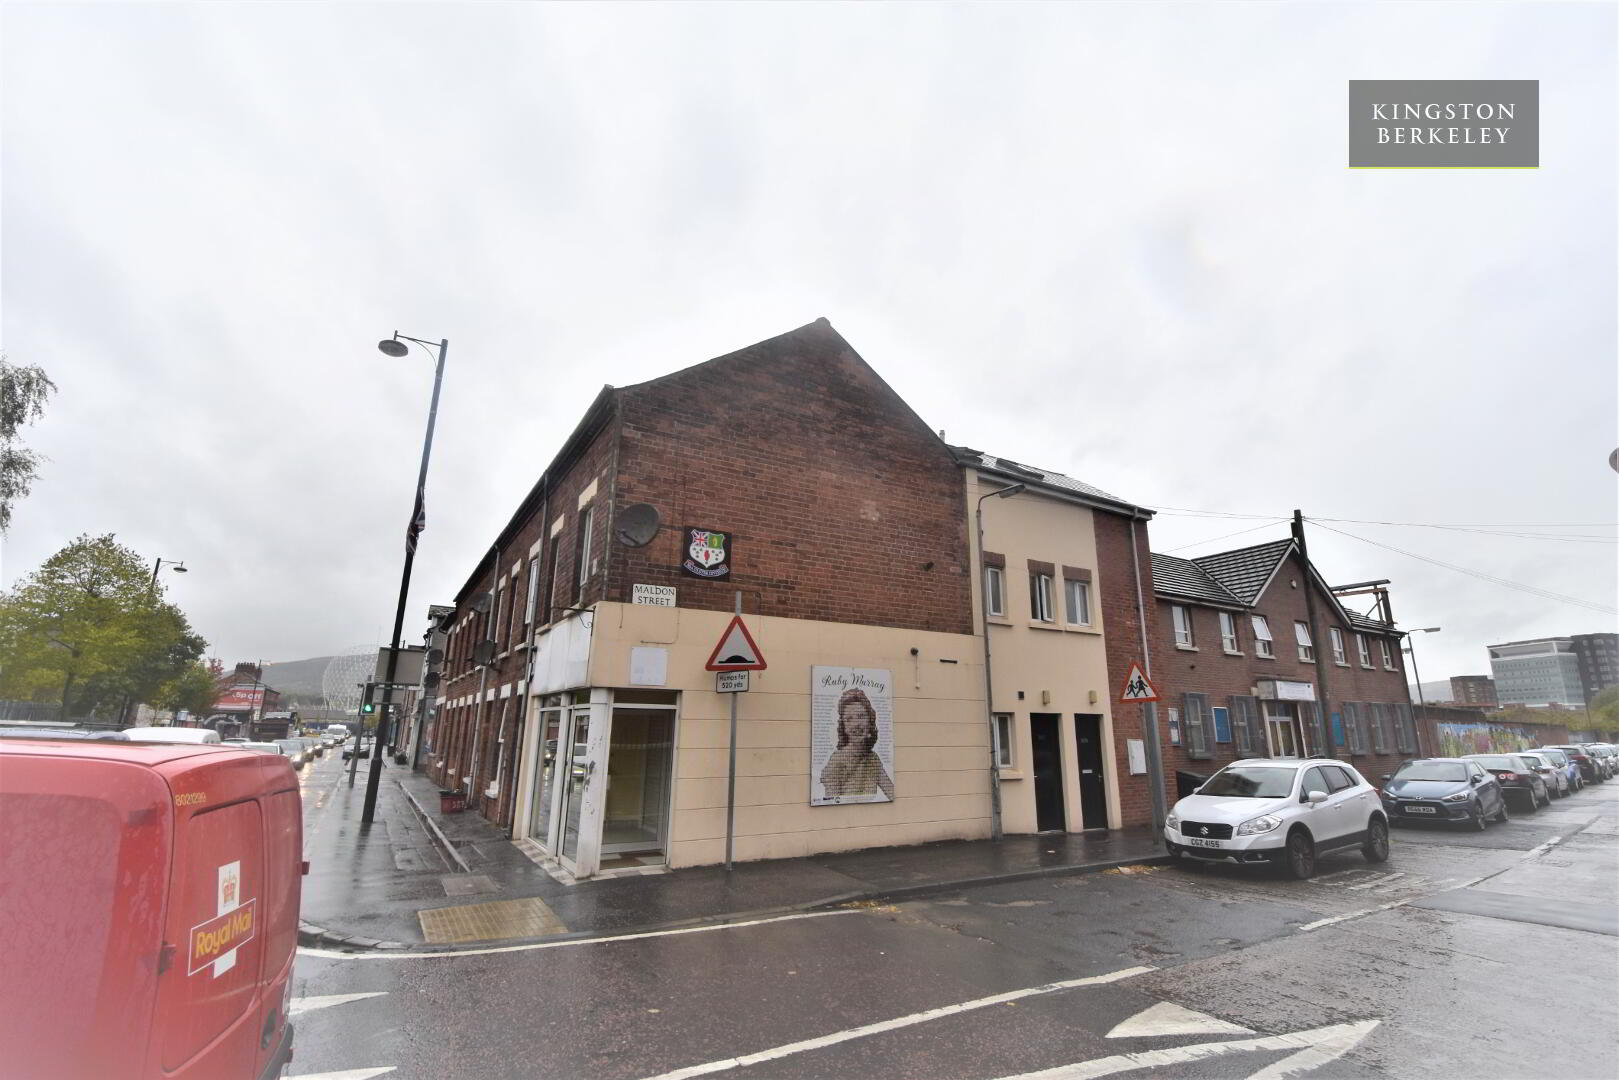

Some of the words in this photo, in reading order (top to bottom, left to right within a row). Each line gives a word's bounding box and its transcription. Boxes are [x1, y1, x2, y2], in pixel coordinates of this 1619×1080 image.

[634, 585, 675, 596] MALDON
[637, 595, 671, 606] STREET
[721, 681, 733, 689] 520
[821, 674, 848, 690] Ruby
[851, 672, 885, 693] Murray
[1190, 838, 1204, 847] CGZ
[195, 917, 231, 959] Royal
[231, 906, 253, 940] Mail
